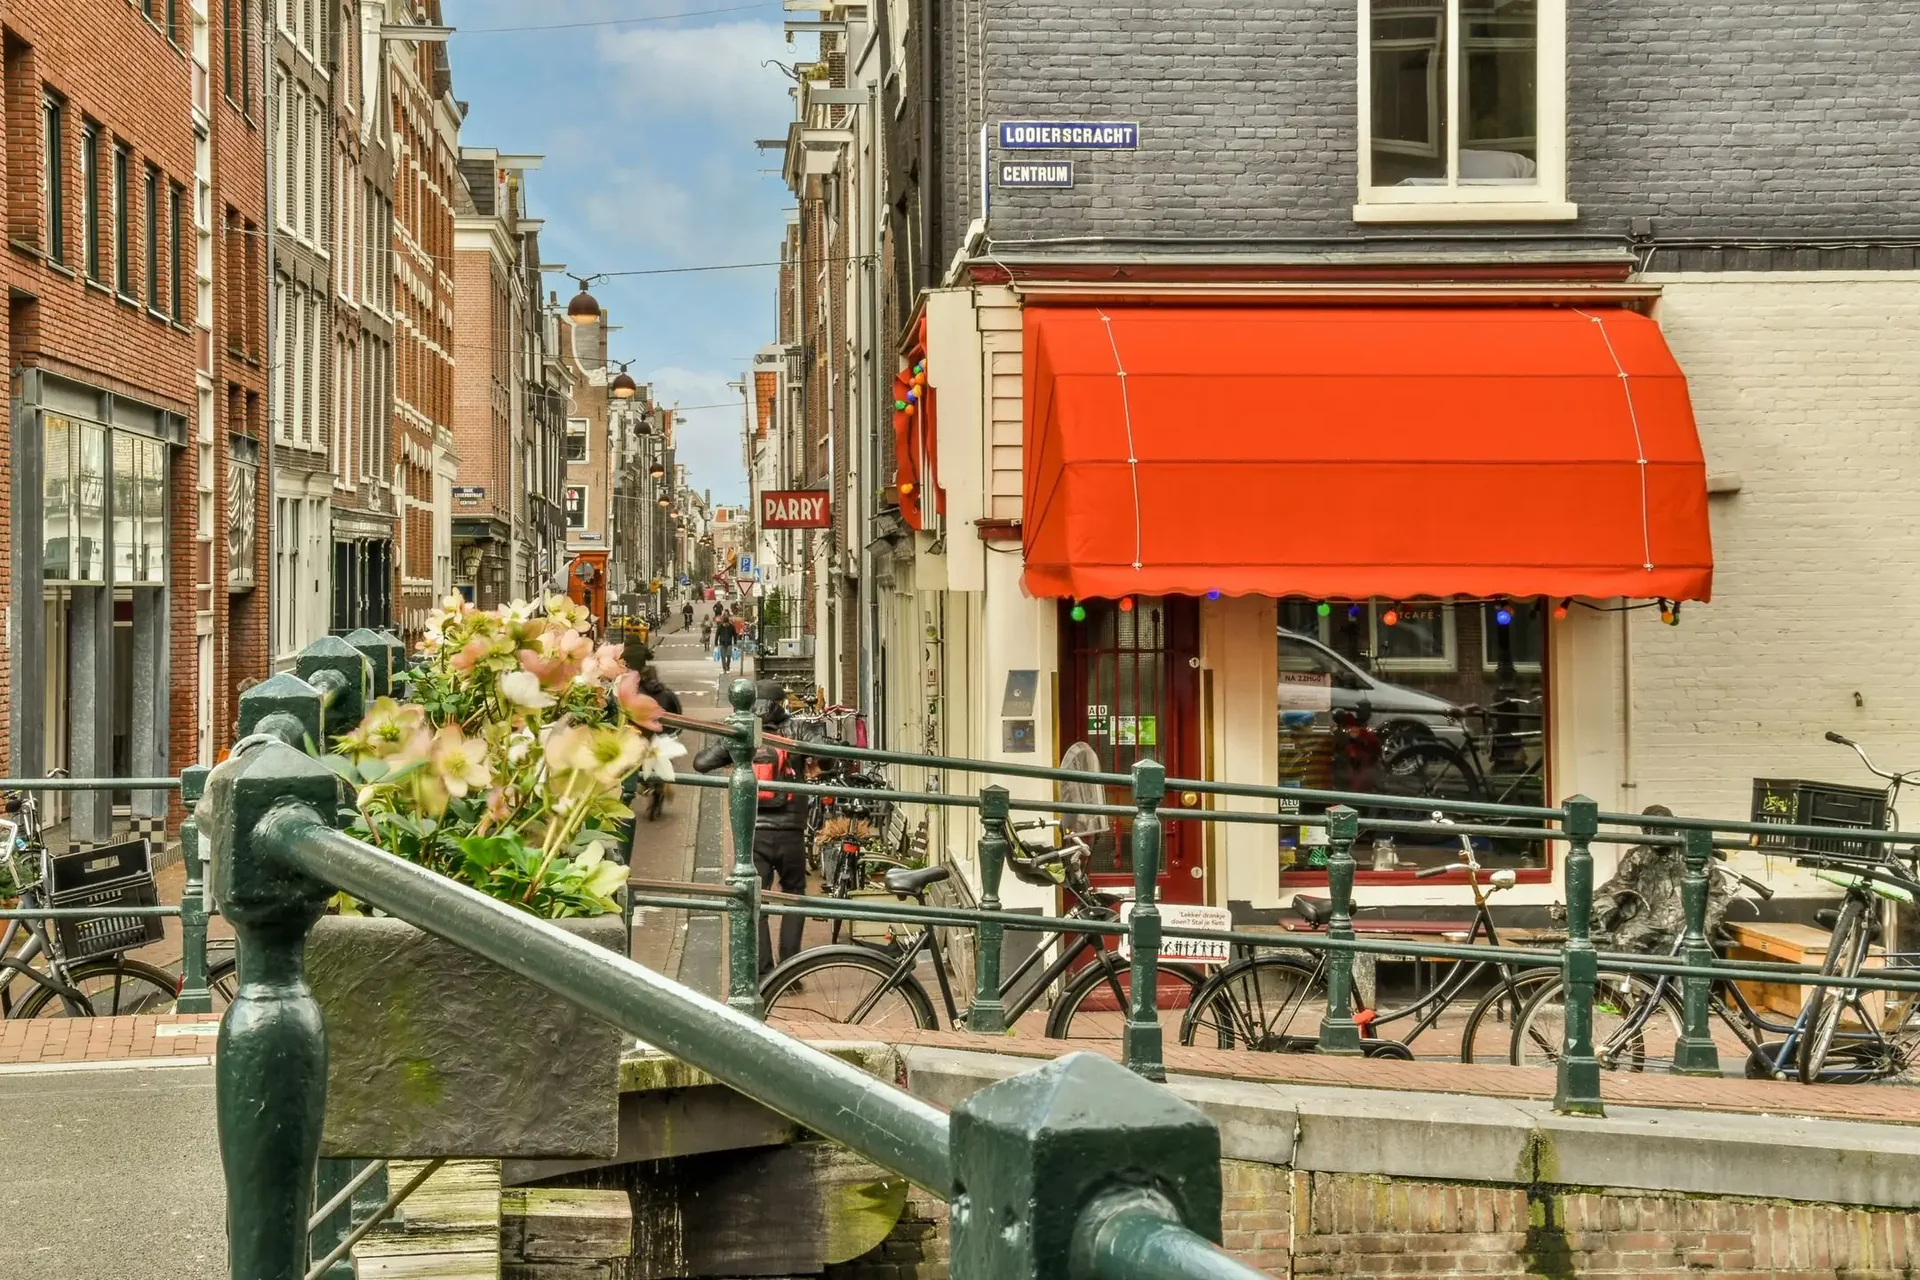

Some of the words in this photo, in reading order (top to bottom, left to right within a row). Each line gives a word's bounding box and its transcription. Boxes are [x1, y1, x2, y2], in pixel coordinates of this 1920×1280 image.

[1006, 127, 1132, 143] LOOIERSGRACHT
[1003, 166, 1068, 182] CENTRUM
[765, 498, 824, 521] PARRY
[1089, 706, 1106, 715] AD
[1202, 912, 1226, 920] drankje
